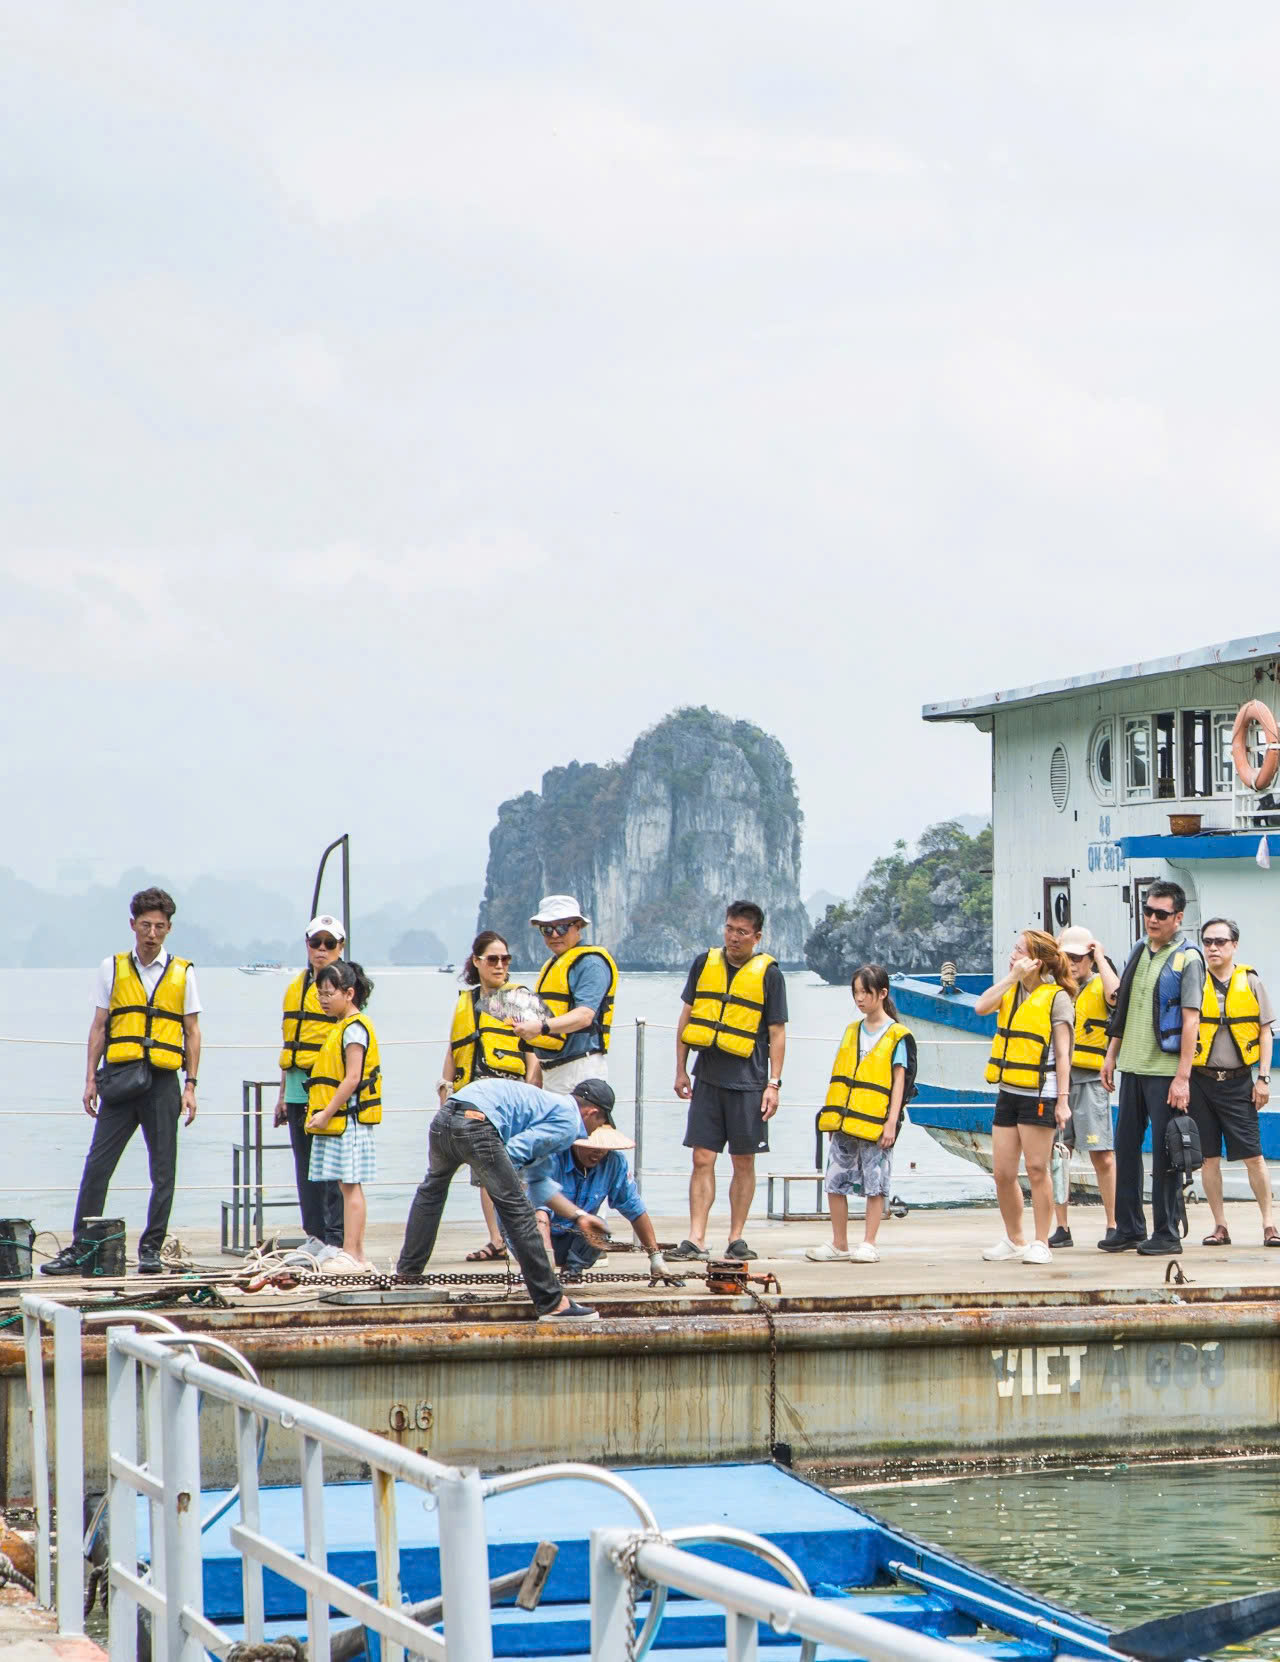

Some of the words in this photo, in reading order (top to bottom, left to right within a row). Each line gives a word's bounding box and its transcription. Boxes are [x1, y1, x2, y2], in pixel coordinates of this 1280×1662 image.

[1099, 815, 1111, 837] 48
[991, 1345, 1088, 1398] VIET
[389, 1400, 434, 1431] 0.6
